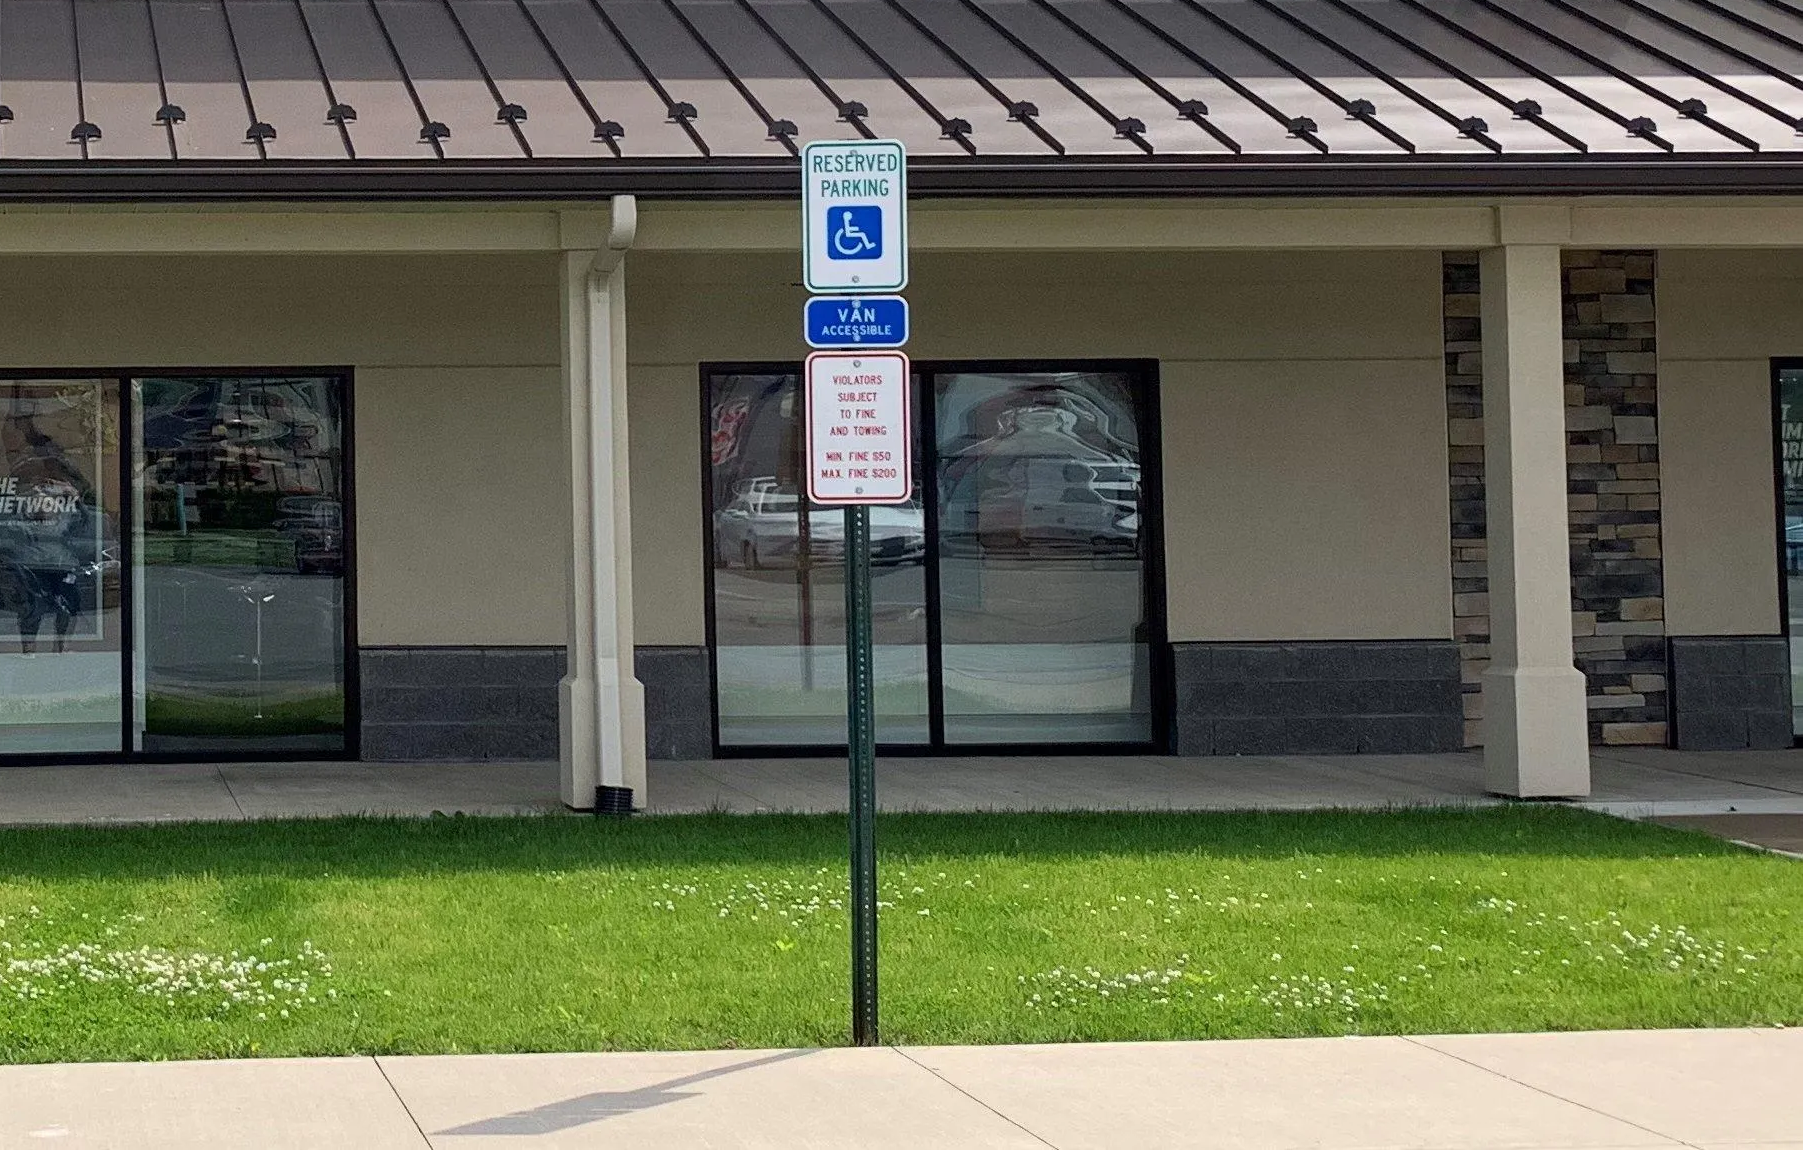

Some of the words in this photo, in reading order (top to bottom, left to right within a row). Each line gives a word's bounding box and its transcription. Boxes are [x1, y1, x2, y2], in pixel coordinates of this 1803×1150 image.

[813, 153, 897, 174] RESERVED
[821, 178, 889, 198] PARKING
[837, 308, 875, 323] VAN
[821, 324, 892, 336] ACCESSIBLE
[832, 375, 883, 385] VIOLATORS
[837, 392, 878, 402] SUBJECT
[840, 409, 852, 419] TO
[855, 409, 876, 419] FINE
[829, 426, 849, 436] AND
[853, 426, 887, 436] TOWING
[848, 452, 869, 461] FINE
[872, 451, 892, 461] $50
[848, 469, 868, 479] FINE
[871, 468, 898, 478] $200
